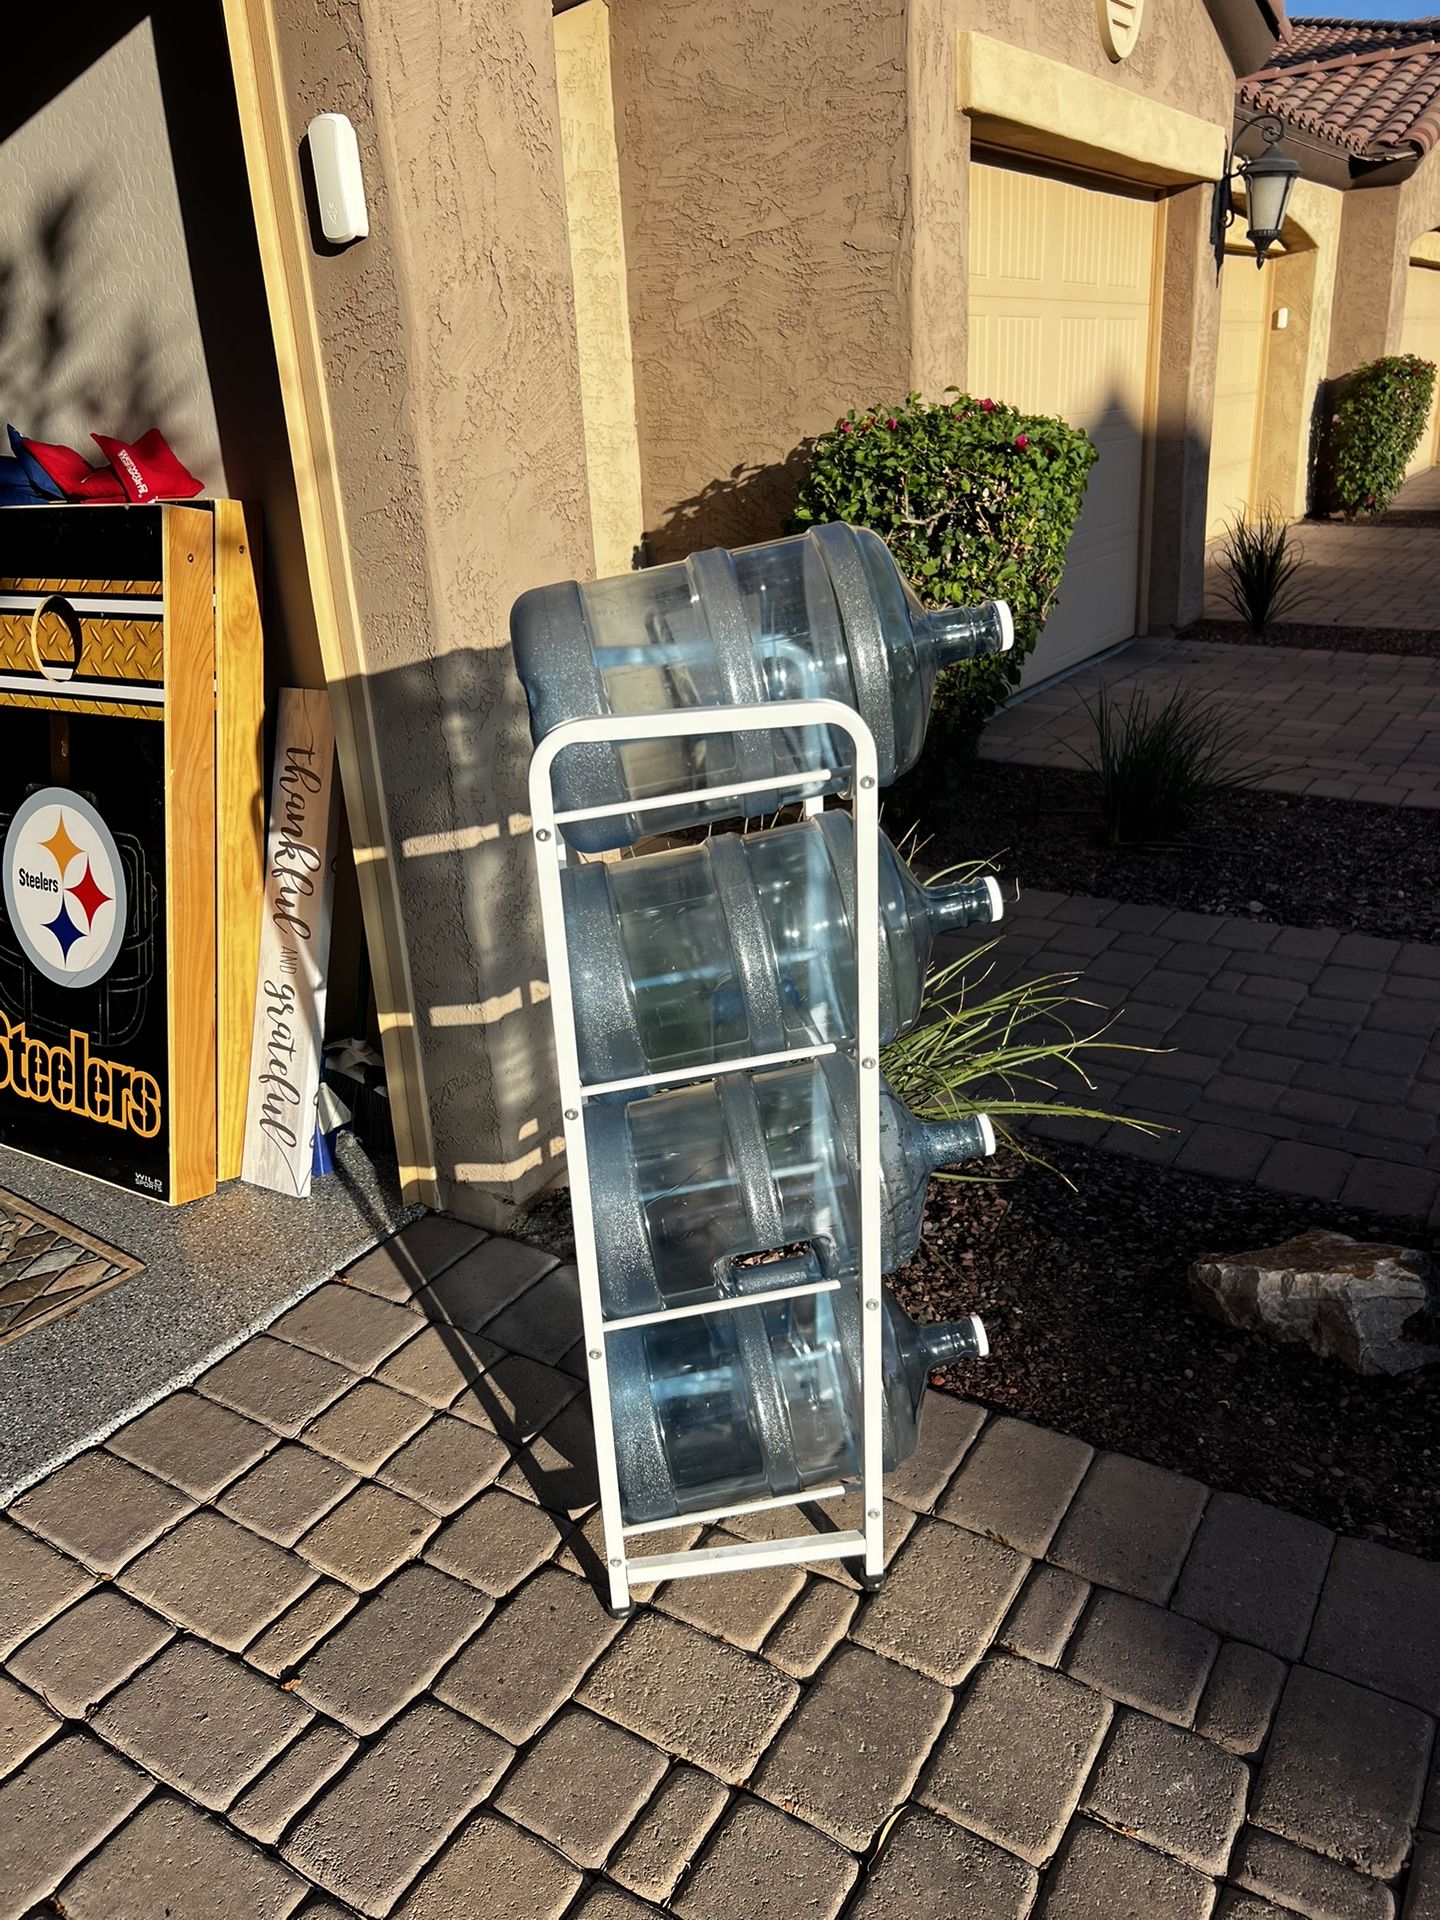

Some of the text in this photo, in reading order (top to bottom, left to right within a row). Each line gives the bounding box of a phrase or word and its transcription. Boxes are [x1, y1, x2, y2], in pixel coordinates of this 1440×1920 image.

[18, 867, 59, 893] Steelers
[256, 747, 322, 1149] thankful AND grateful
[134, 1171, 163, 1187] WILD
[134, 1178, 163, 1193] SPORTS
